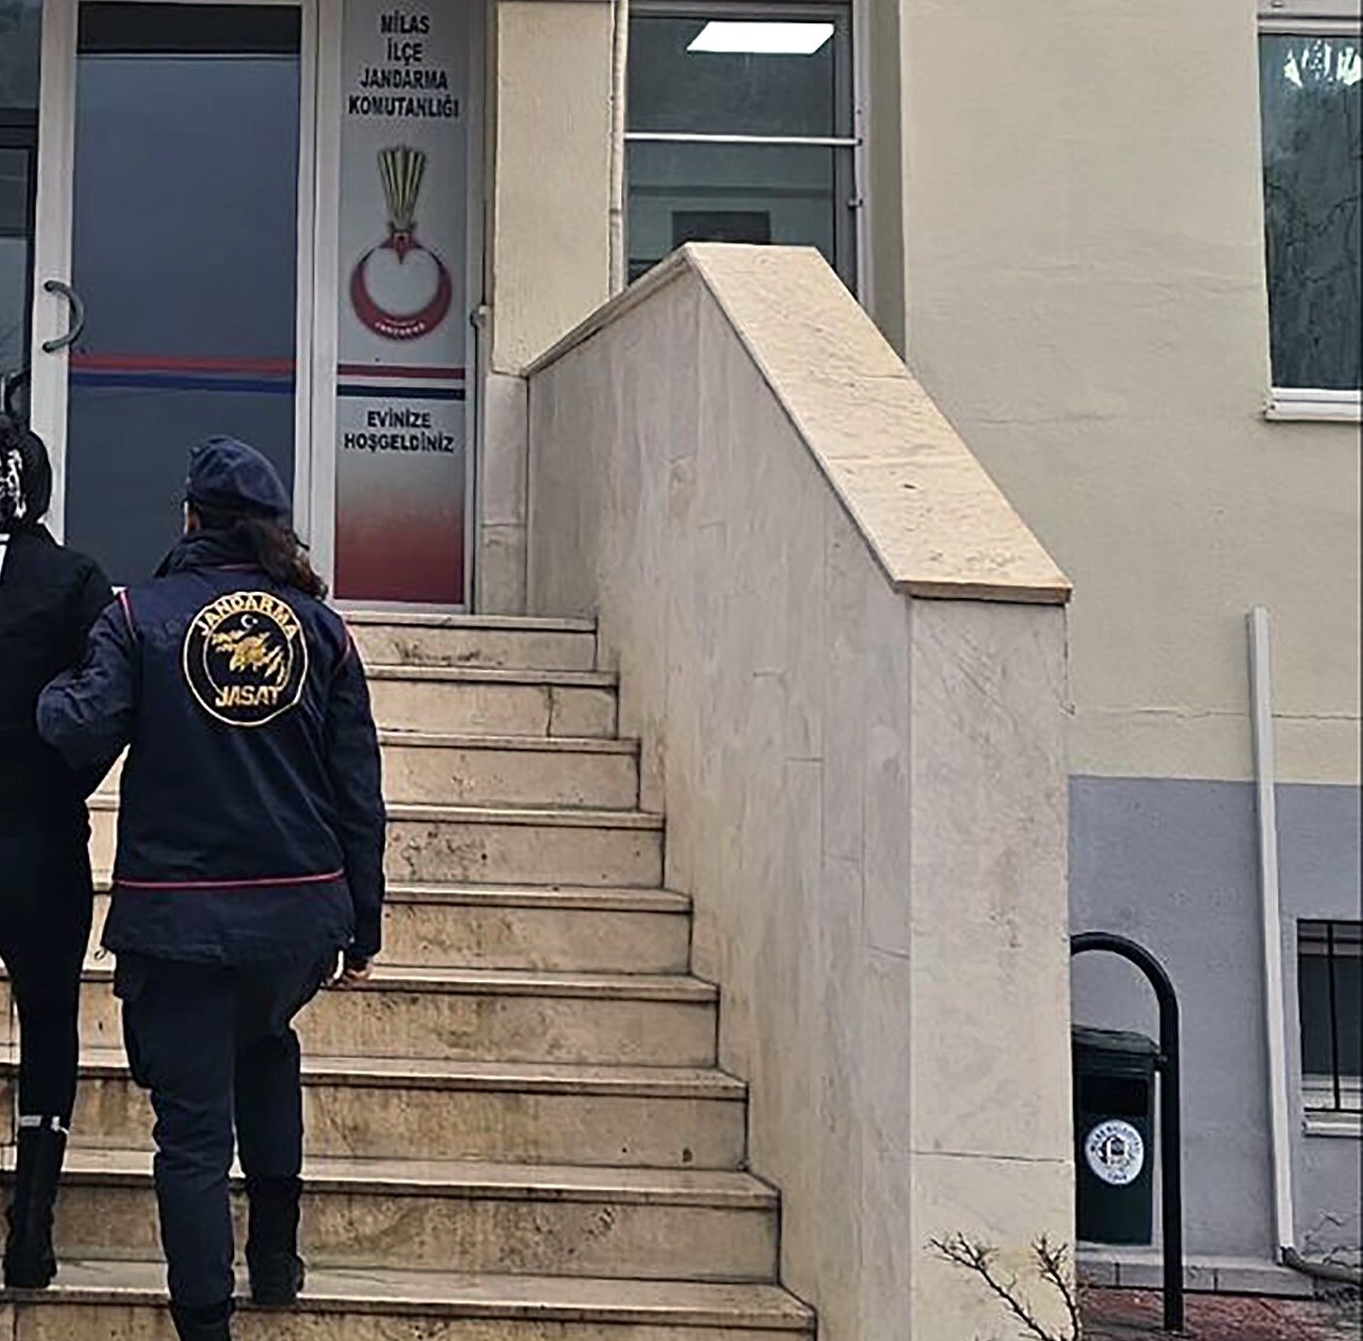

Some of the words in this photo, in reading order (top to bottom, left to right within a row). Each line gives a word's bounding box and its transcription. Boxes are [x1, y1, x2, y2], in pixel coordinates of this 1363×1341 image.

[380, 9, 431, 35] MİLAS
[386, 37, 424, 67] İLÇE
[359, 67, 449, 91] JANDARMA
[347, 94, 460, 118] KOMUTANLIĞI
[367, 407, 432, 429] EVİNİZE
[343, 431, 455, 453] HOŞGELDİNİZ
[196, 593, 299, 642] JANDARMA
[214, 684, 280, 707] JASAT
